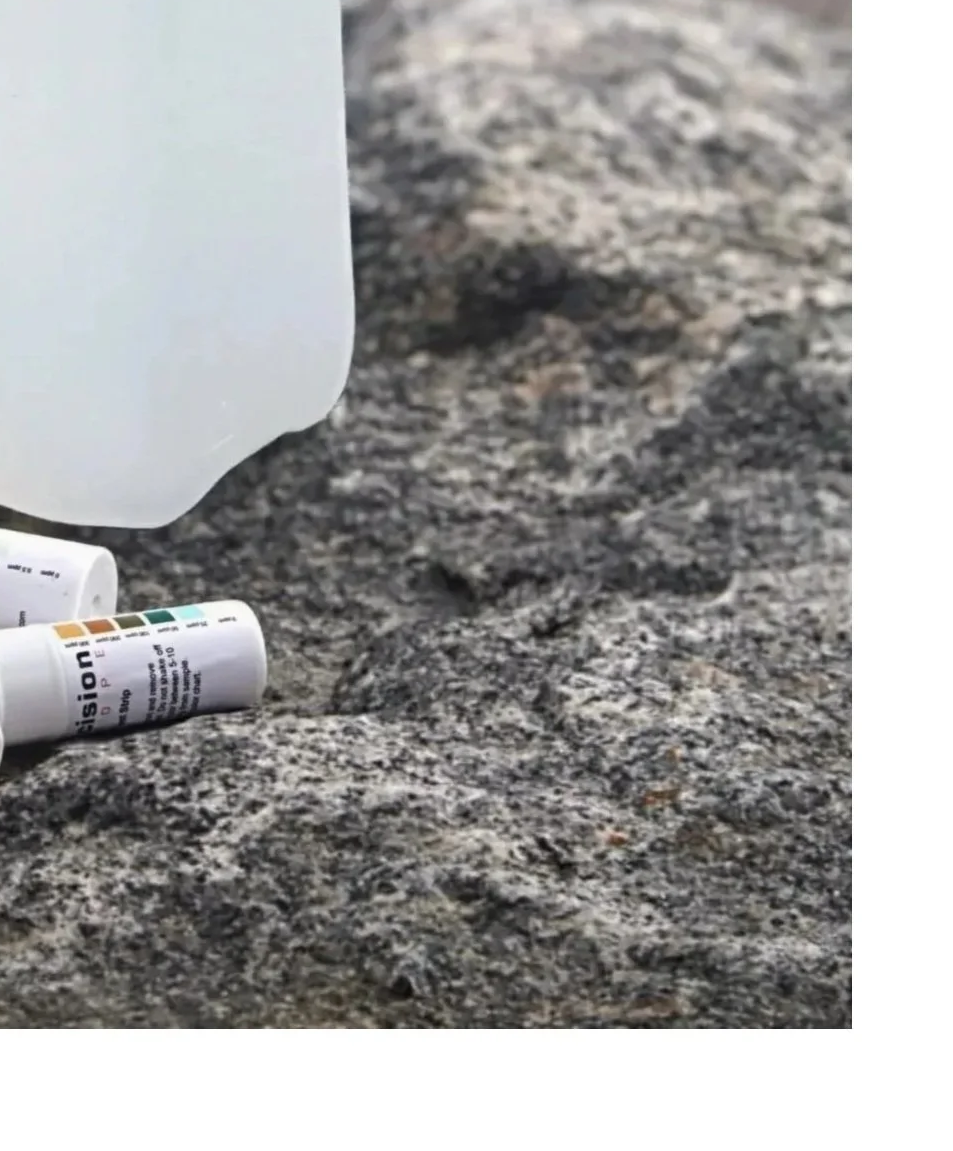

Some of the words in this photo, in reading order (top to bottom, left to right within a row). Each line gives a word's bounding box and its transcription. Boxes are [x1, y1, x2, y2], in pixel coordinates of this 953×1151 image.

[152, 644, 164, 656] off
[164, 646, 178, 668] 5-10
[147, 662, 158, 697] remove
[158, 658, 168, 686] shake
[119, 688, 134, 714] Strip
